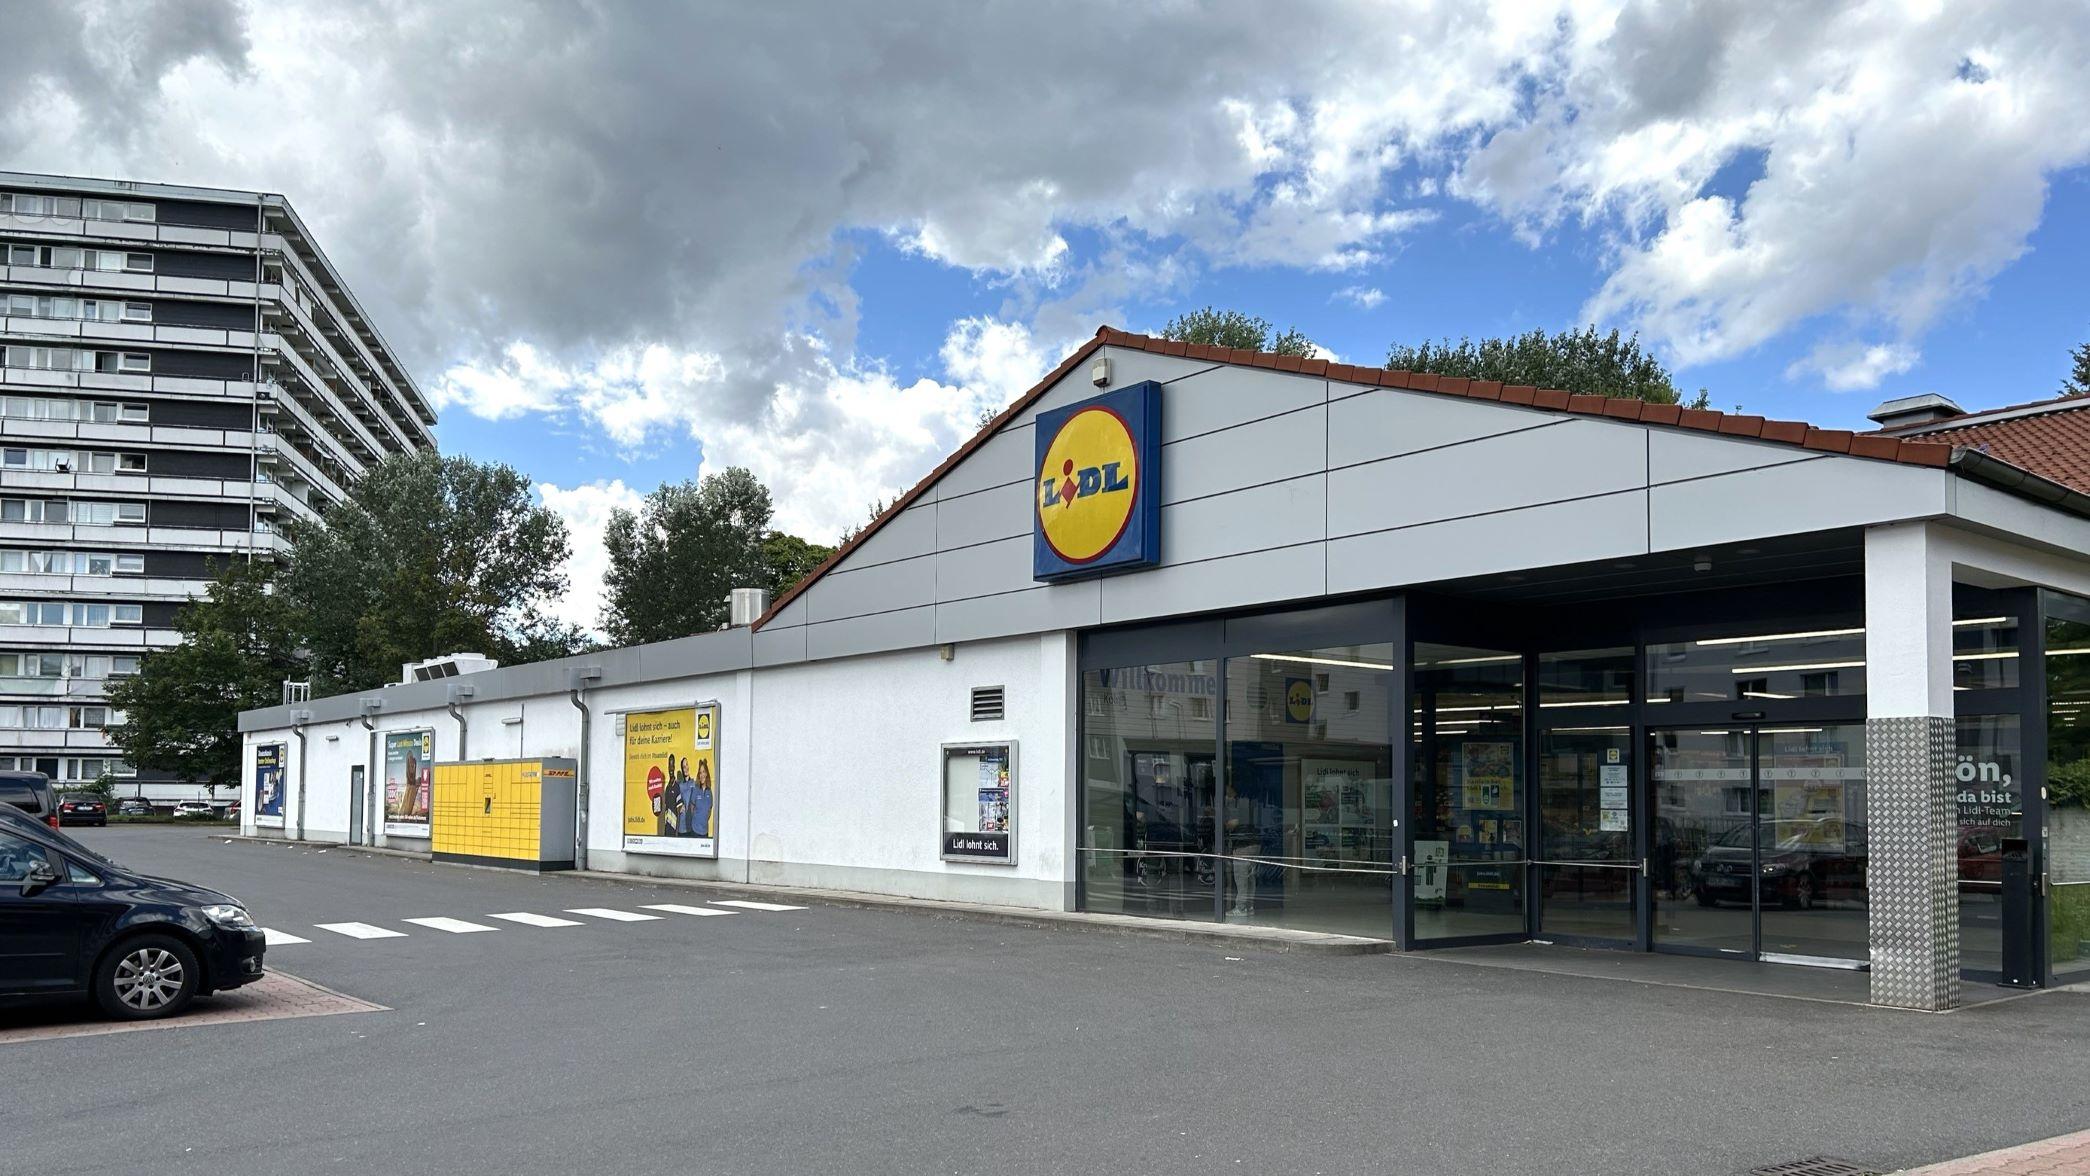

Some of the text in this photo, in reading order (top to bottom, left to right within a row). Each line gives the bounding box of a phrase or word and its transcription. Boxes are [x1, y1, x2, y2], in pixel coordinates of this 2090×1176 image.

[1043, 459, 1128, 509] LIDL
[1098, 667, 1216, 695] Willkomme
[1289, 692, 1313, 706] LIDL
[629, 723, 638, 733] Lidl
[639, 722, 652, 732] lohnt
[652, 721, 662, 731] sich
[668, 720, 680, 730] auch
[637, 735, 650, 745] deine
[651, 734, 672, 744] Karriere!
[1317, 767, 1329, 776] Lidl
[1955, 755, 2012, 787] ön,
[1956, 790, 2012, 803] da bist
[1963, 805, 2011, 815] Lidl-Team
[1977, 818, 1991, 826] auf
[1992, 818, 2011, 827] dich
[953, 838, 999, 851] Lidl lohnt sich.
